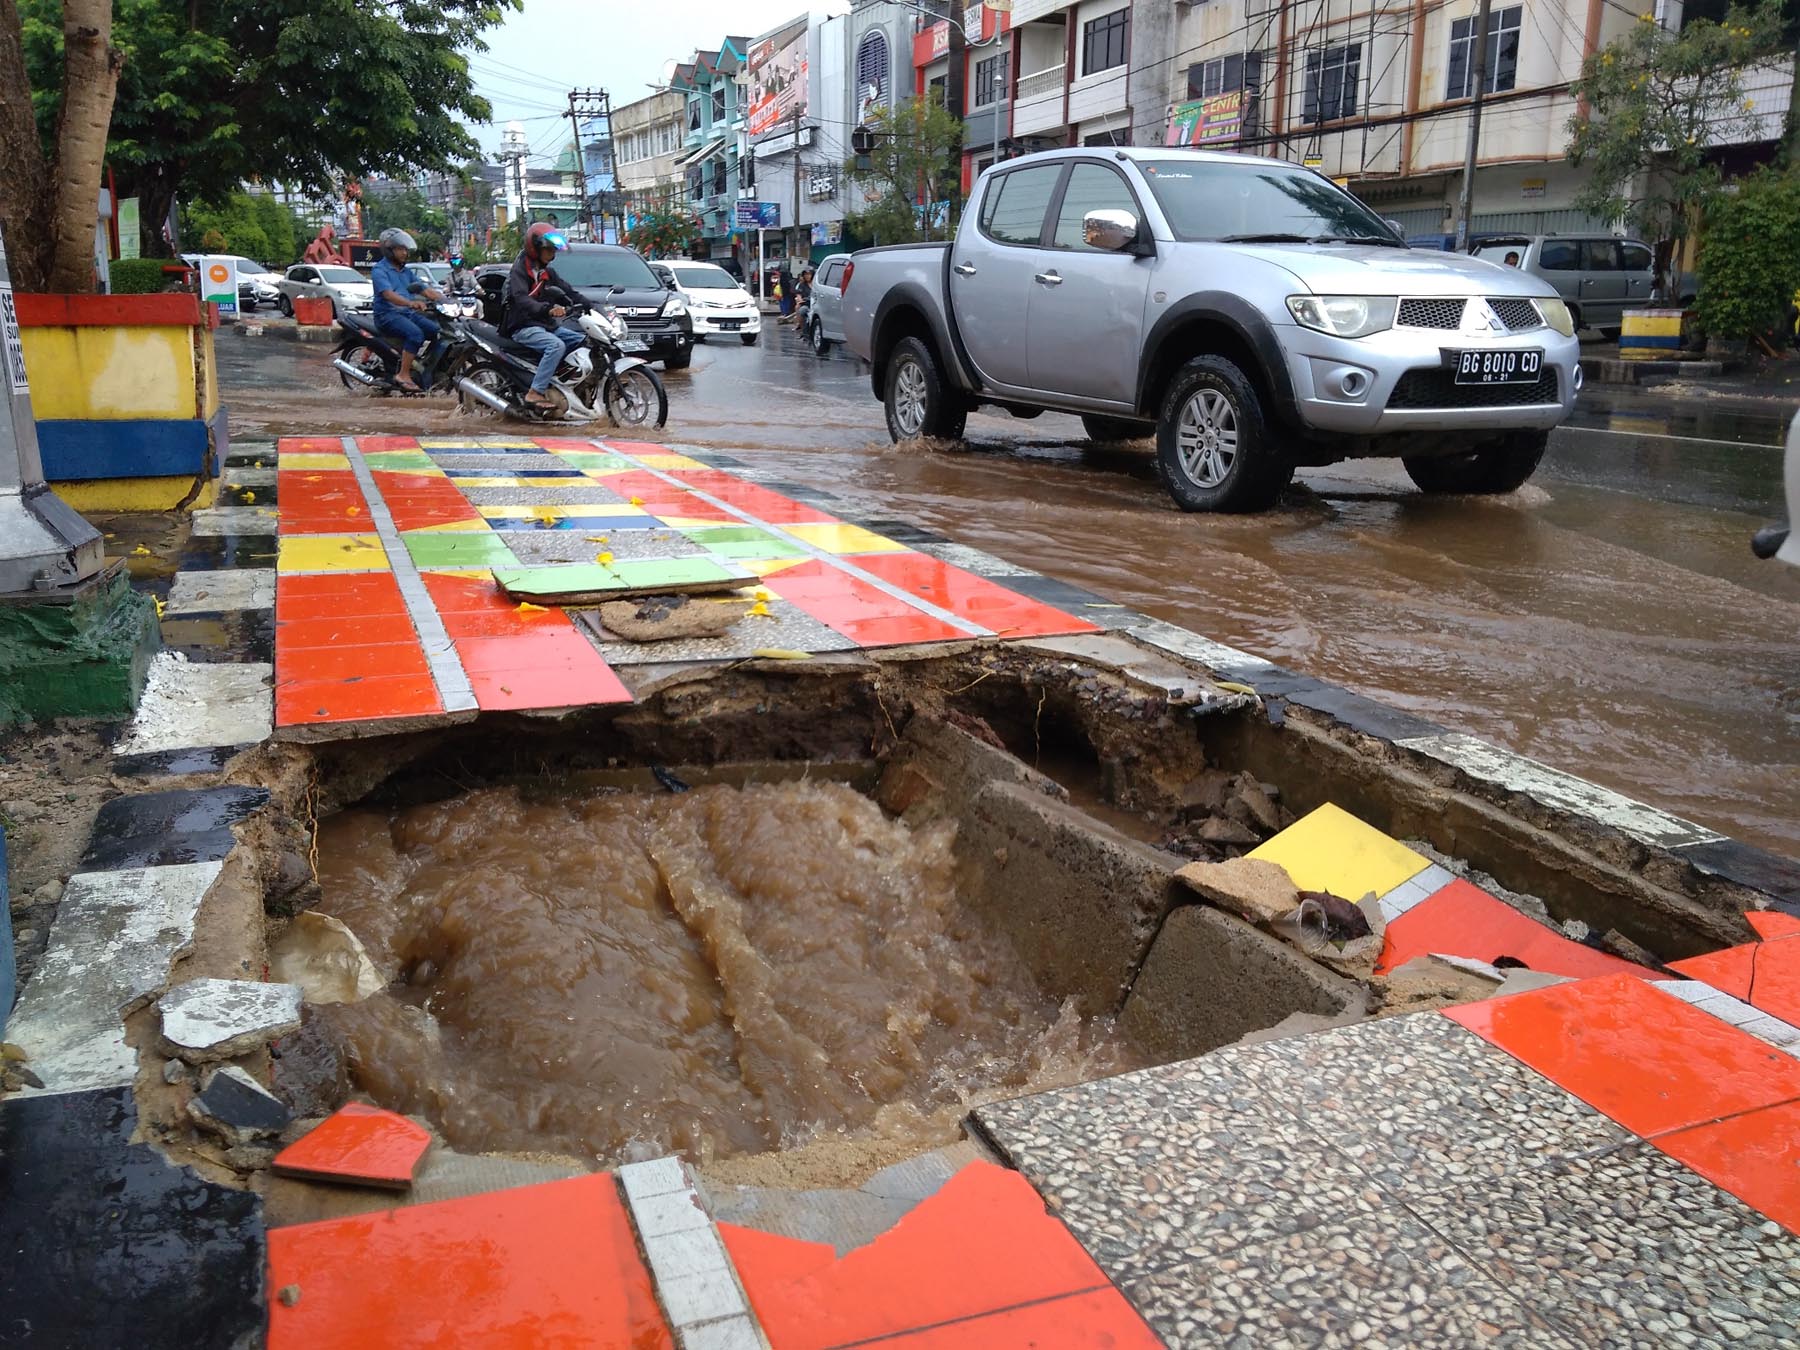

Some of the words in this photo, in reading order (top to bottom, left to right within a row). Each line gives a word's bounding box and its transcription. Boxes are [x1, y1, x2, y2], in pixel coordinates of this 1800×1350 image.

[2, 293, 16, 323] SE
[218, 303, 234, 311] LUAR
[1462, 353, 1480, 373] BG
[1483, 352, 1516, 373] 8010
[1521, 352, 1539, 372] CD
